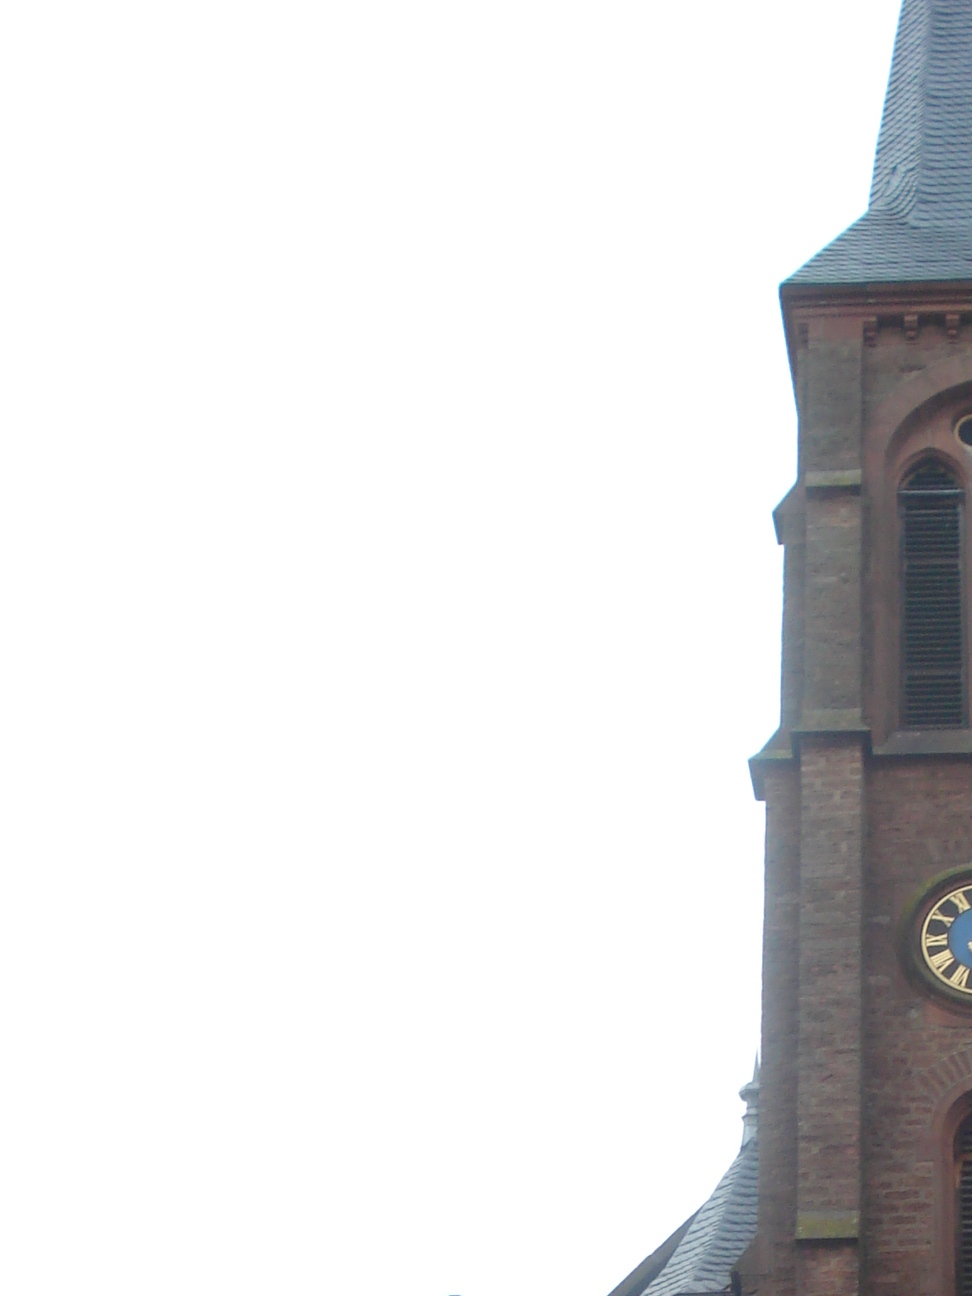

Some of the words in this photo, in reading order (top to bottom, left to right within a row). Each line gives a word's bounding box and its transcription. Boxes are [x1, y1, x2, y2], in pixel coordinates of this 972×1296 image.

[949, 891, 971, 914] XI
[931, 909, 955, 928] X
[926, 933, 948, 947] IX
[949, 964, 971, 987] VII
